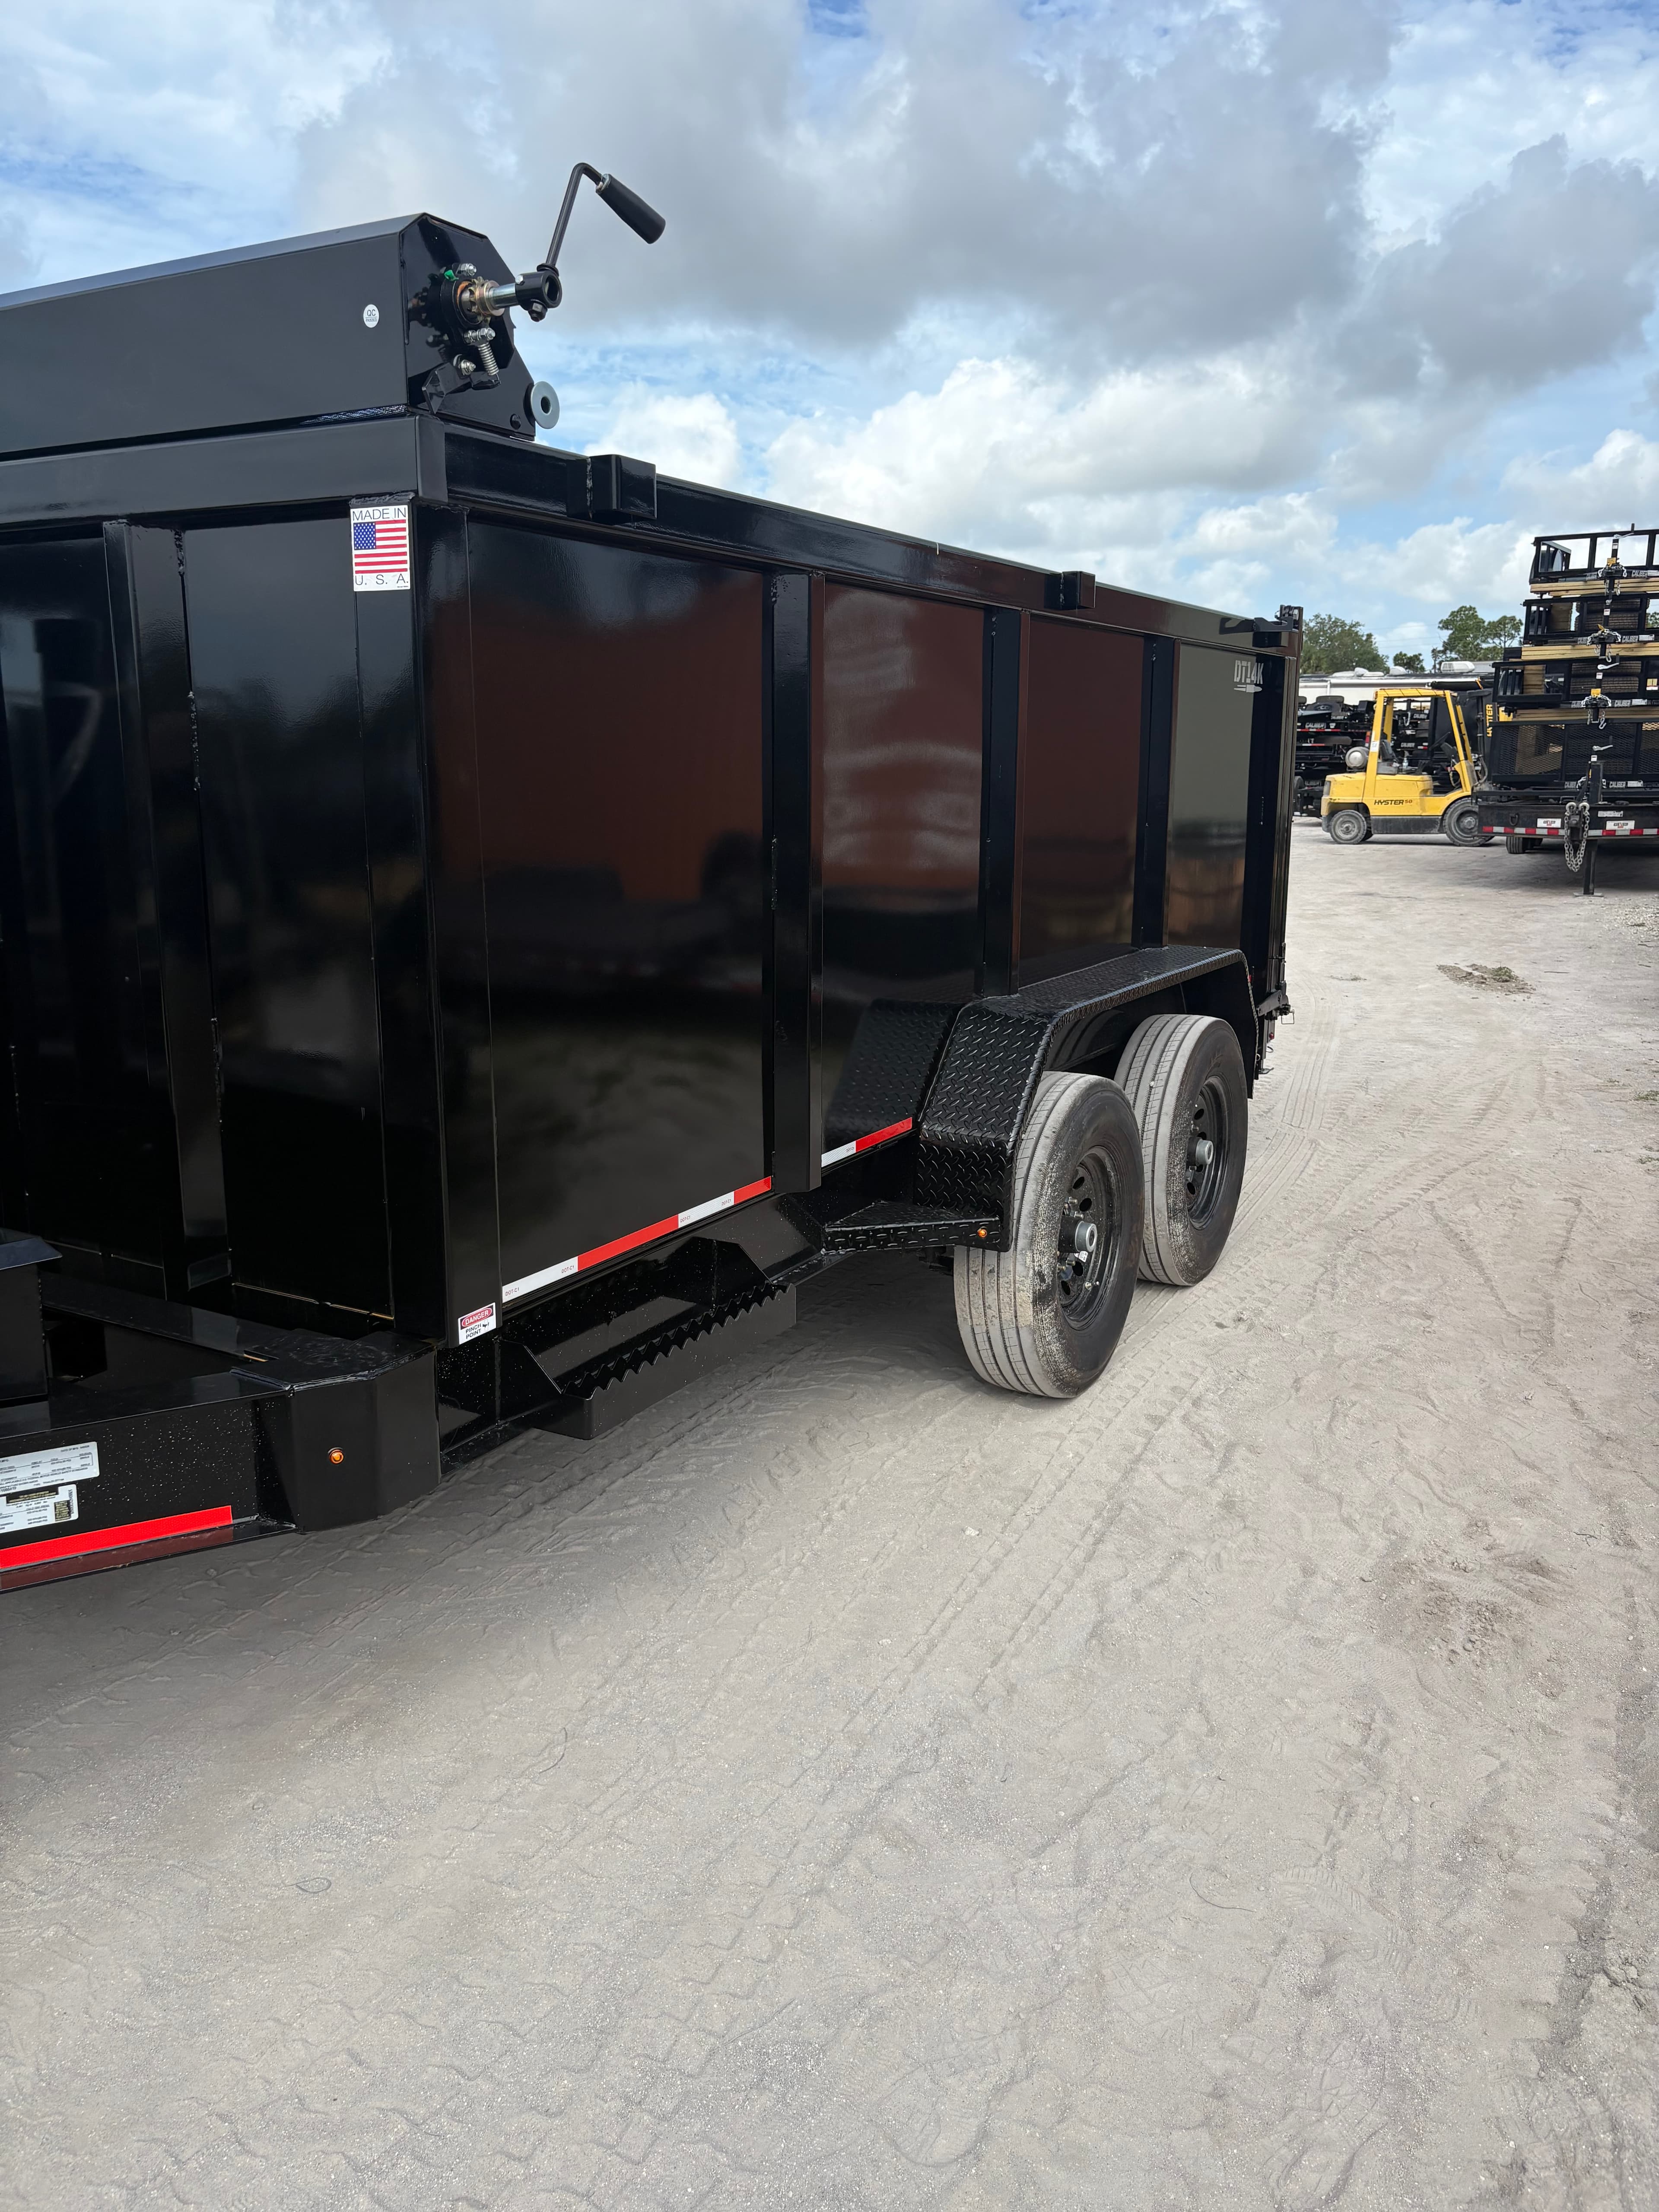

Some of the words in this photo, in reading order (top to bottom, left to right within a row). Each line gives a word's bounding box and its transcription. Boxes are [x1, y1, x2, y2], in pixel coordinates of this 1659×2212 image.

[352, 508, 390, 521] MADE
[394, 507, 406, 518] IN
[561, 1265, 574, 1274] DOT-C1
[505, 1287, 519, 1297] DOT-C1
[465, 1309, 489, 1325] DANGER
[466, 1323, 481, 1334] PINCH
[466, 1328, 481, 1339] POINT
